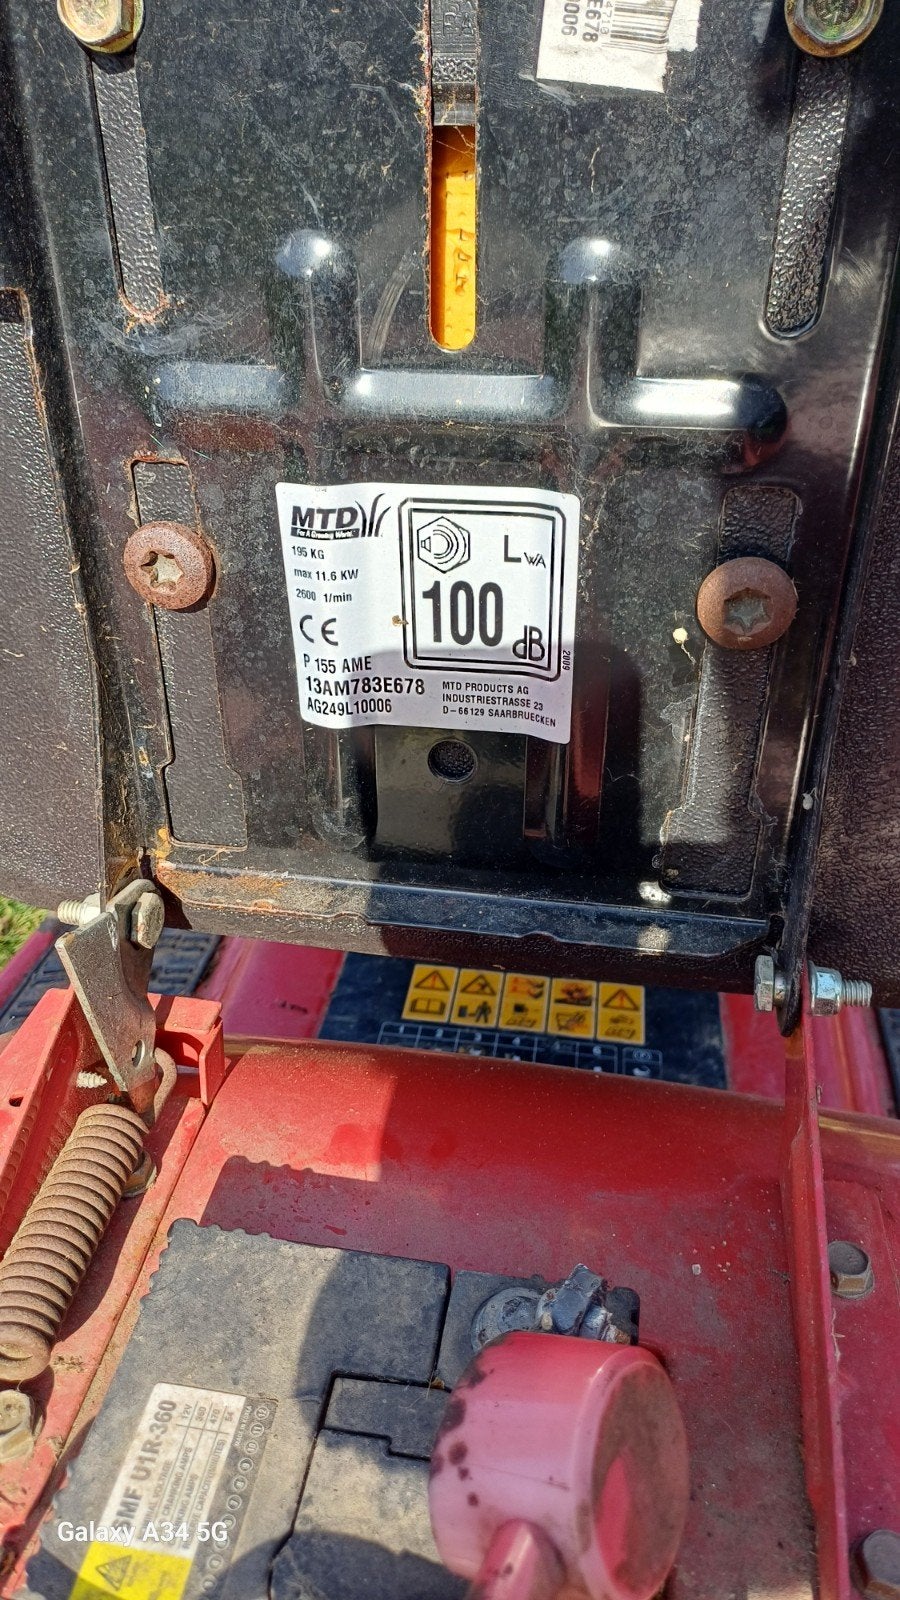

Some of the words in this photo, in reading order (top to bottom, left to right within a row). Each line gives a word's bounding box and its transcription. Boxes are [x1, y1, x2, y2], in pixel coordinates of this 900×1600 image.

[561, 0, 580, 36] 006
[291, 505, 359, 530] MTD
[291, 545, 308, 558] 195
[310, 548, 325, 560] KG
[294, 567, 312, 580] max
[315, 570, 337, 582] 11.6
[340, 568, 359, 581] KW
[295, 588, 317, 602] 2600
[323, 592, 352, 603] 1/min
[422, 580, 504, 647] 100
[512, 624, 546, 662] dB
[303, 653, 310, 668] P
[315, 658, 337, 674] 155
[342, 655, 373, 672] AME
[562, 650, 571, 671] 2009
[305, 676, 425, 696] 13AM783E678
[442, 680, 463, 691] MTD
[465, 682, 514, 694] PRODUCTS
[517, 685, 529, 696] AG
[307, 696, 392, 716] AG249L10006
[442, 693, 531, 709] INDUSTRIESTRASSE
[533, 701, 543, 711] 23
[488, 708, 556, 728] SAARBRUECKEN
[129, 1400, 177, 1480] U1R-360
